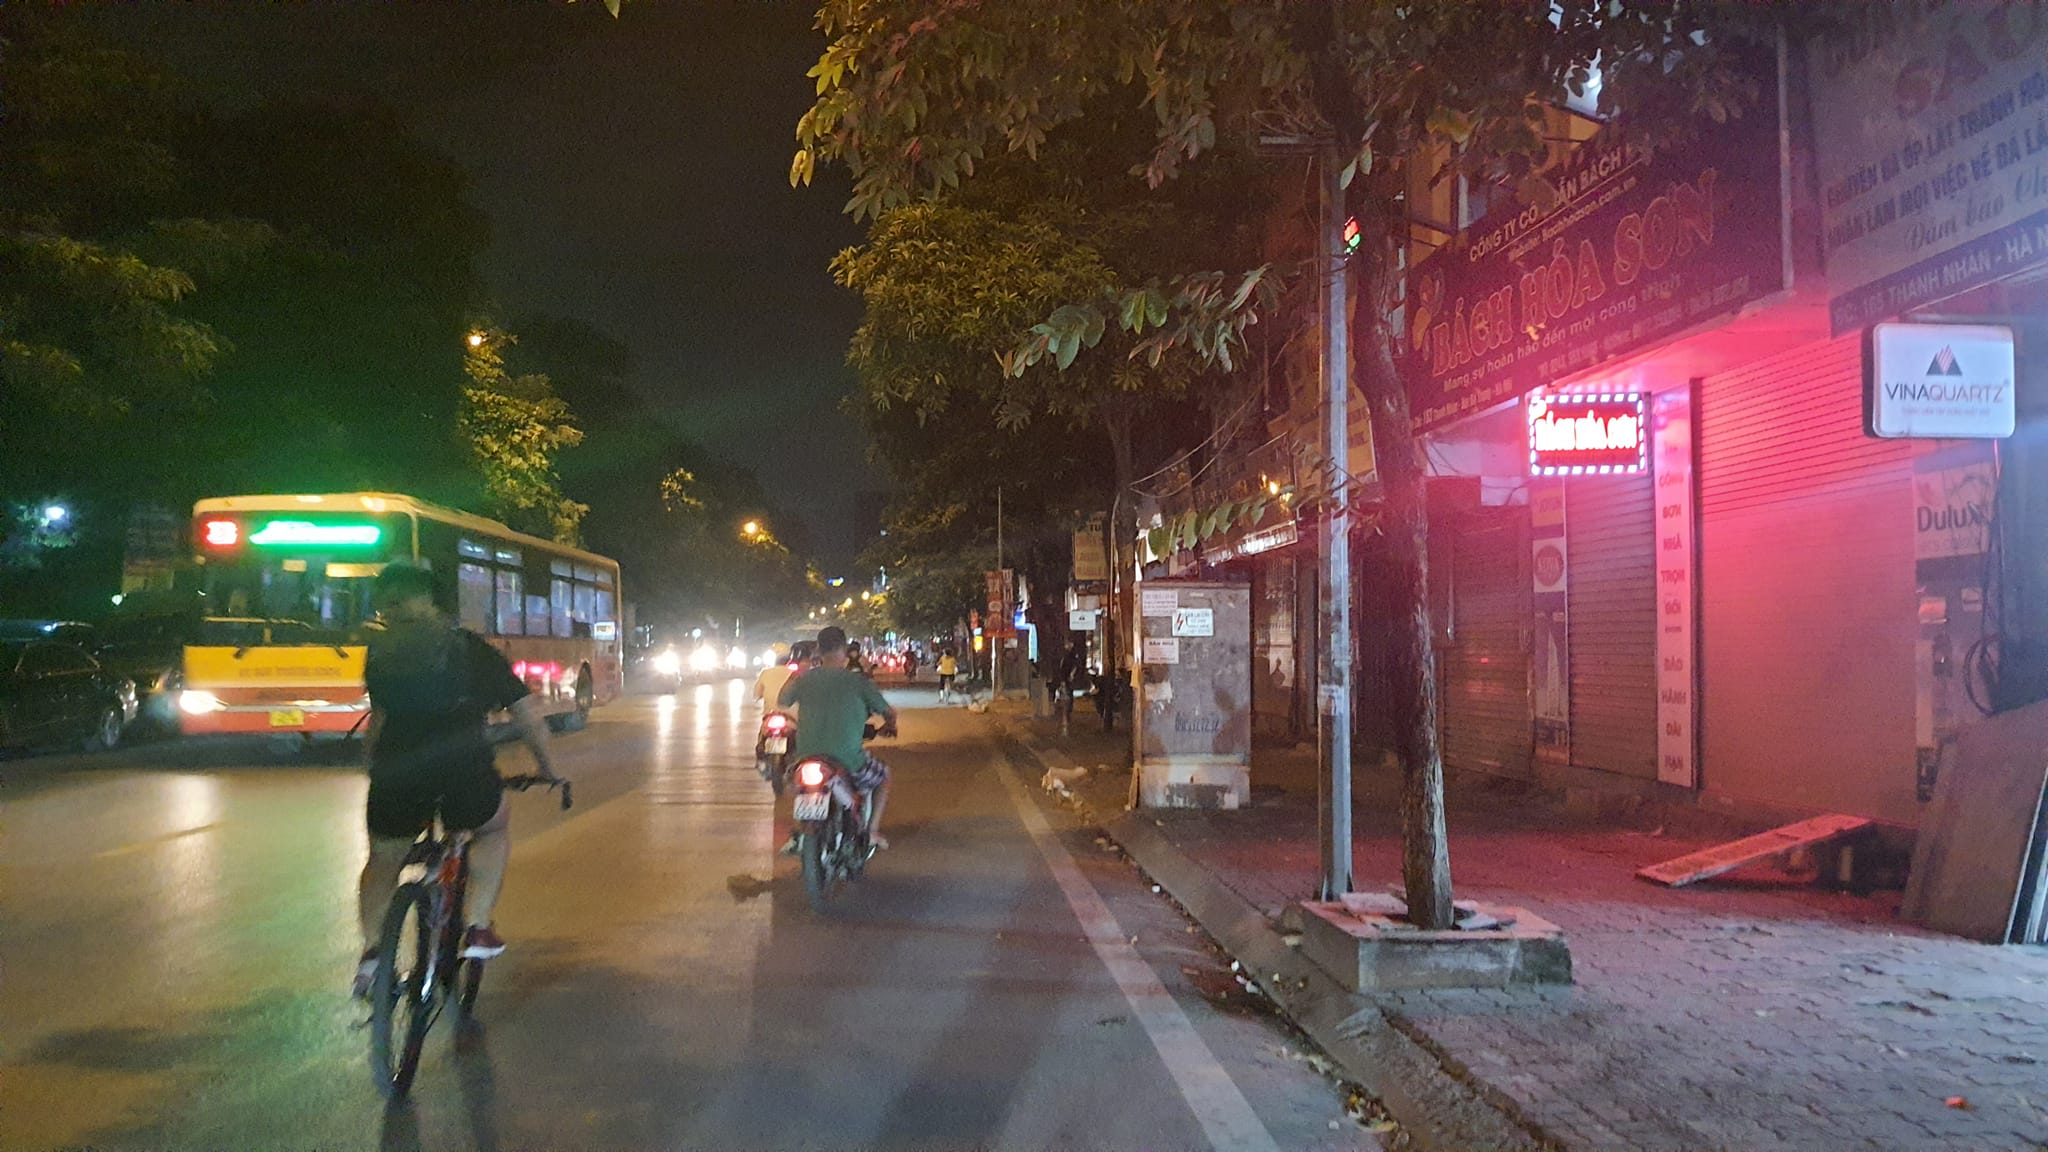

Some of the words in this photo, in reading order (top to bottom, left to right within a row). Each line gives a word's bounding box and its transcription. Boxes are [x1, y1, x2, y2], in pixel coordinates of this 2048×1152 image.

[1469, 231, 1502, 263] CÔNG
[1503, 219, 1517, 242] TY
[1579, 148, 1622, 191] BÁCH
[2003, 227, 2033, 263] HÀ
[1431, 285, 1514, 379] BÁCH
[1519, 237, 1607, 335] HÓA
[1884, 382, 2006, 404] VINAQUARTZ
[1916, 500, 1981, 533] Dulux
